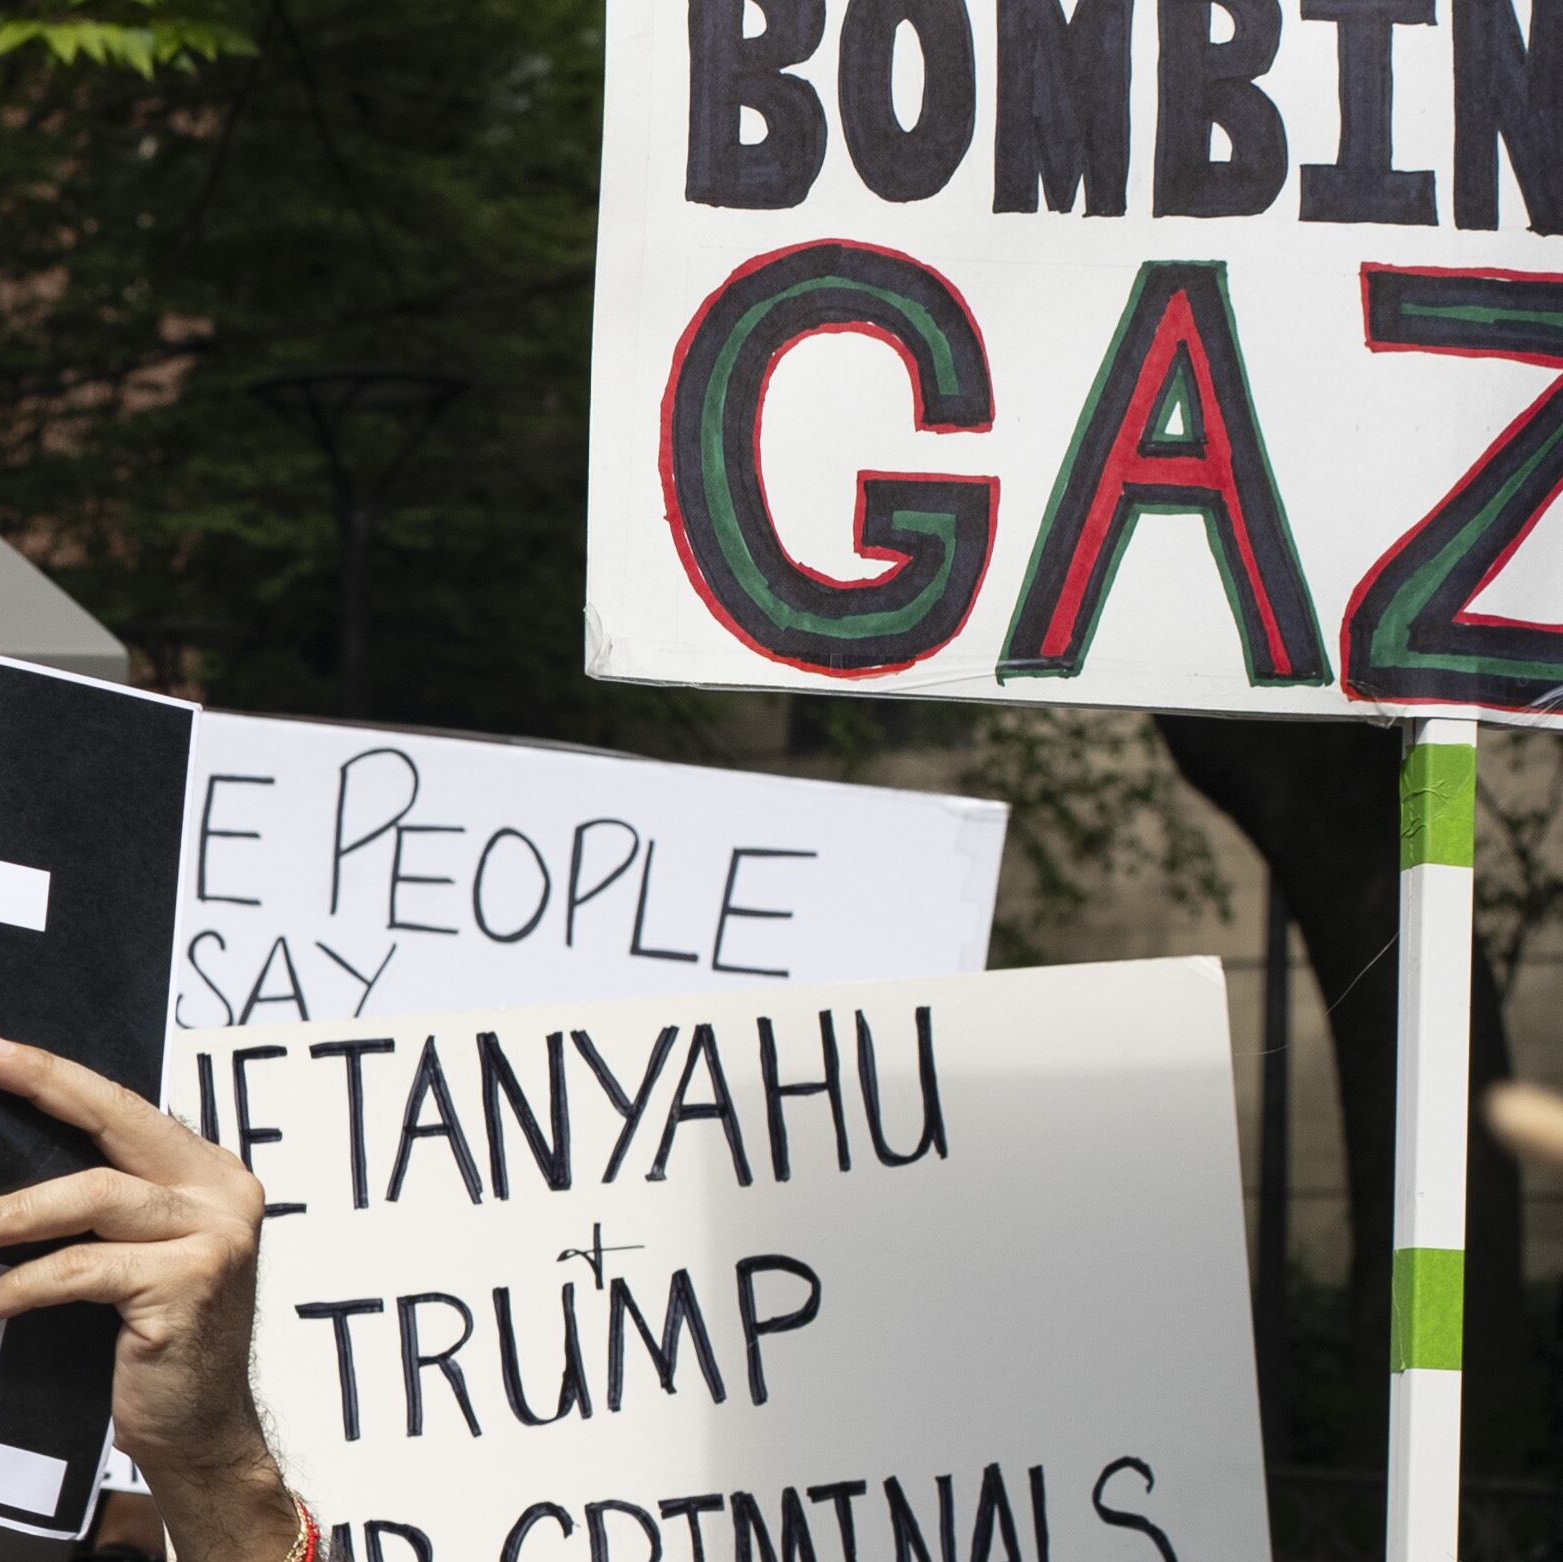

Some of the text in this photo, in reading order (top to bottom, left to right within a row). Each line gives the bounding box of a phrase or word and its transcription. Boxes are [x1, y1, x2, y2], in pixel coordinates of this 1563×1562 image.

[330, 748, 818, 979] PEOPLE
[174, 930, 398, 1029] SAY
[293, 1254, 822, 1441] TRUMP
